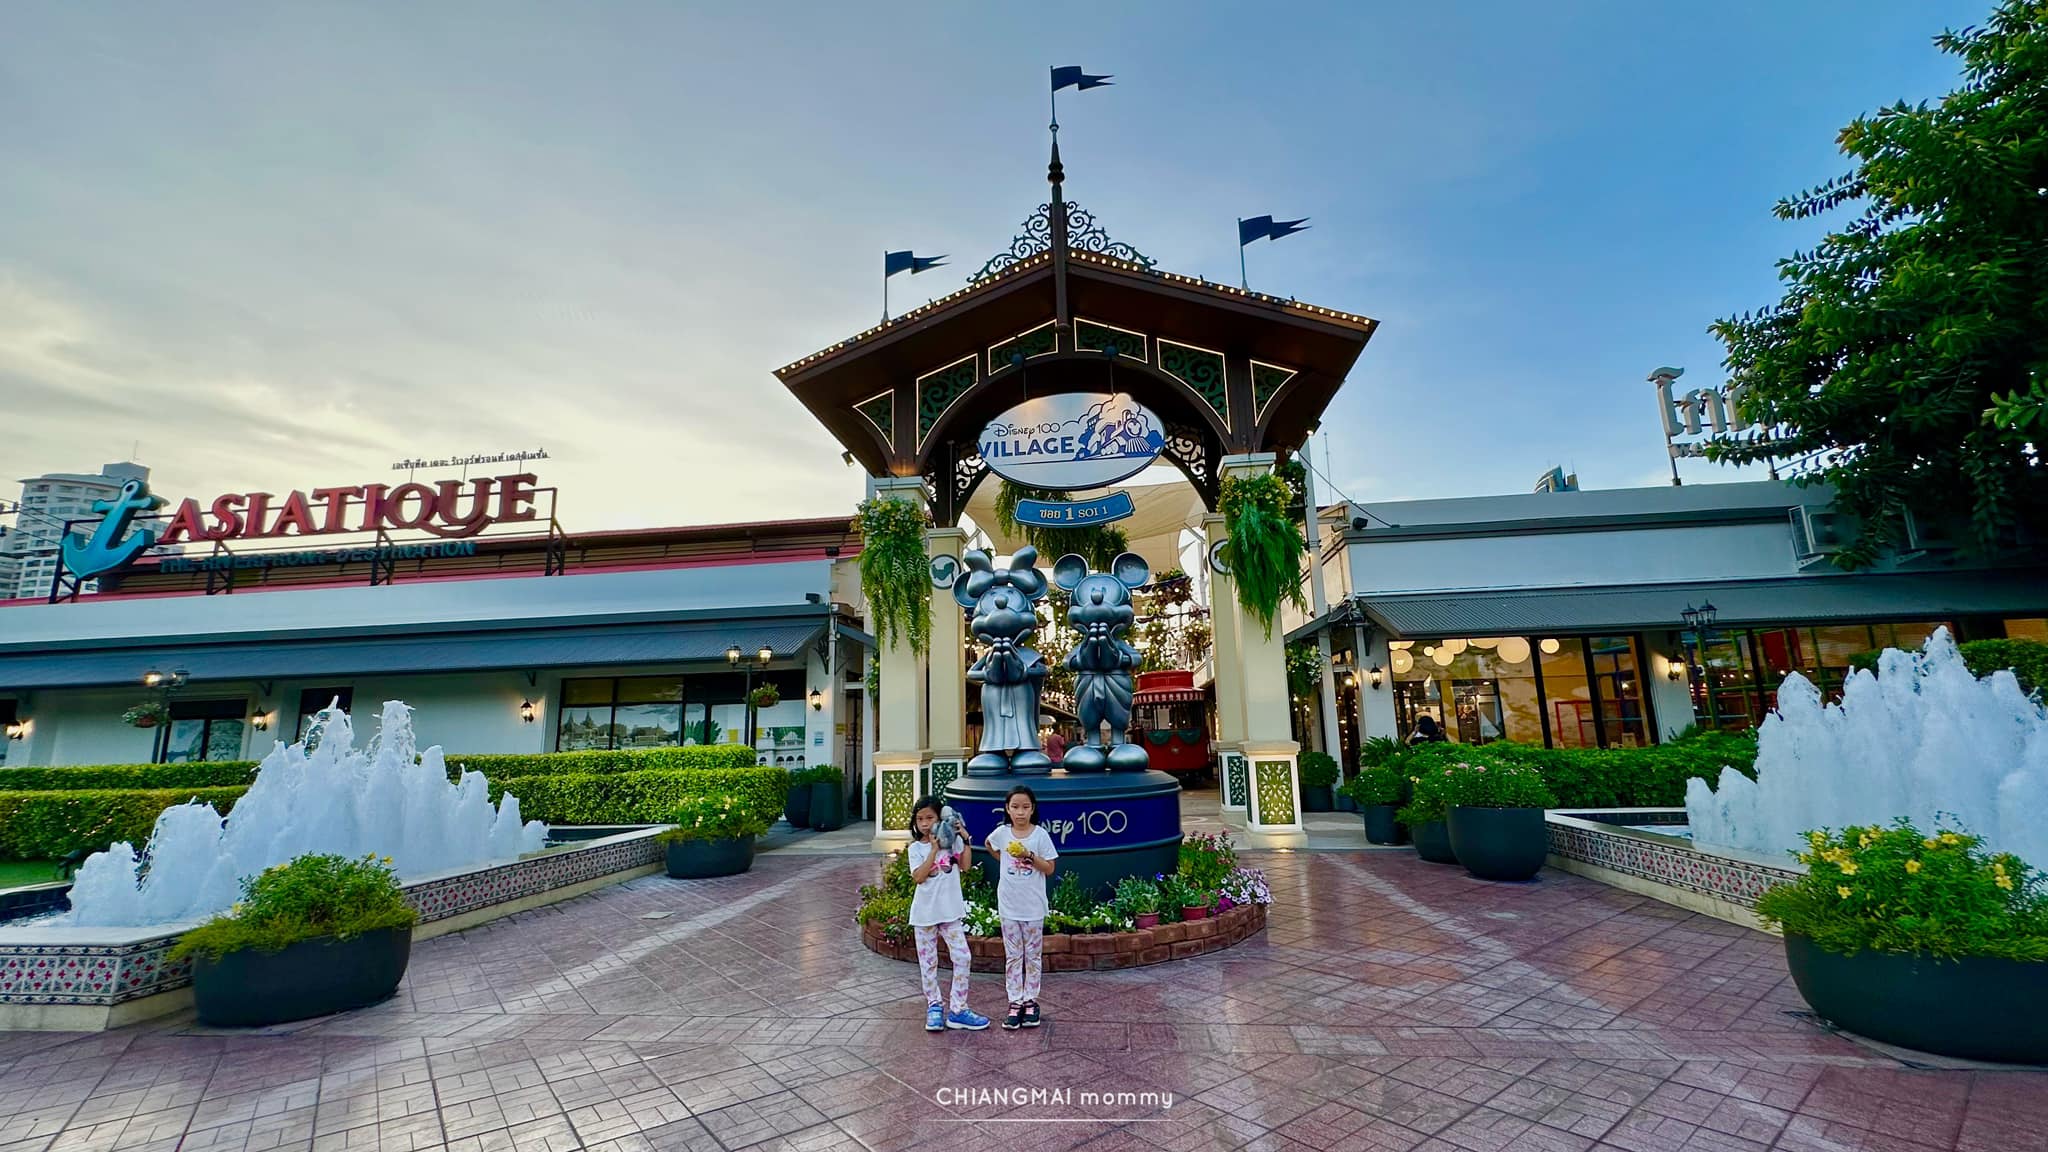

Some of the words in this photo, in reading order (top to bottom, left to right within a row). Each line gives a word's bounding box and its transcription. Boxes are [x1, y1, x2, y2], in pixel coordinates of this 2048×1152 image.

[991, 423, 1036, 439] Disney
[1038, 423, 1061, 434] 100
[976, 436, 1075, 459] VILLAGE
[156, 472, 538, 543] ASIATIQUE
[1039, 509, 1061, 519] ซอย
[1065, 507, 1075, 520] 1
[1078, 509, 1099, 518] SOI
[1102, 506, 1109, 515] 1
[1077, 809, 1128, 835] 100
